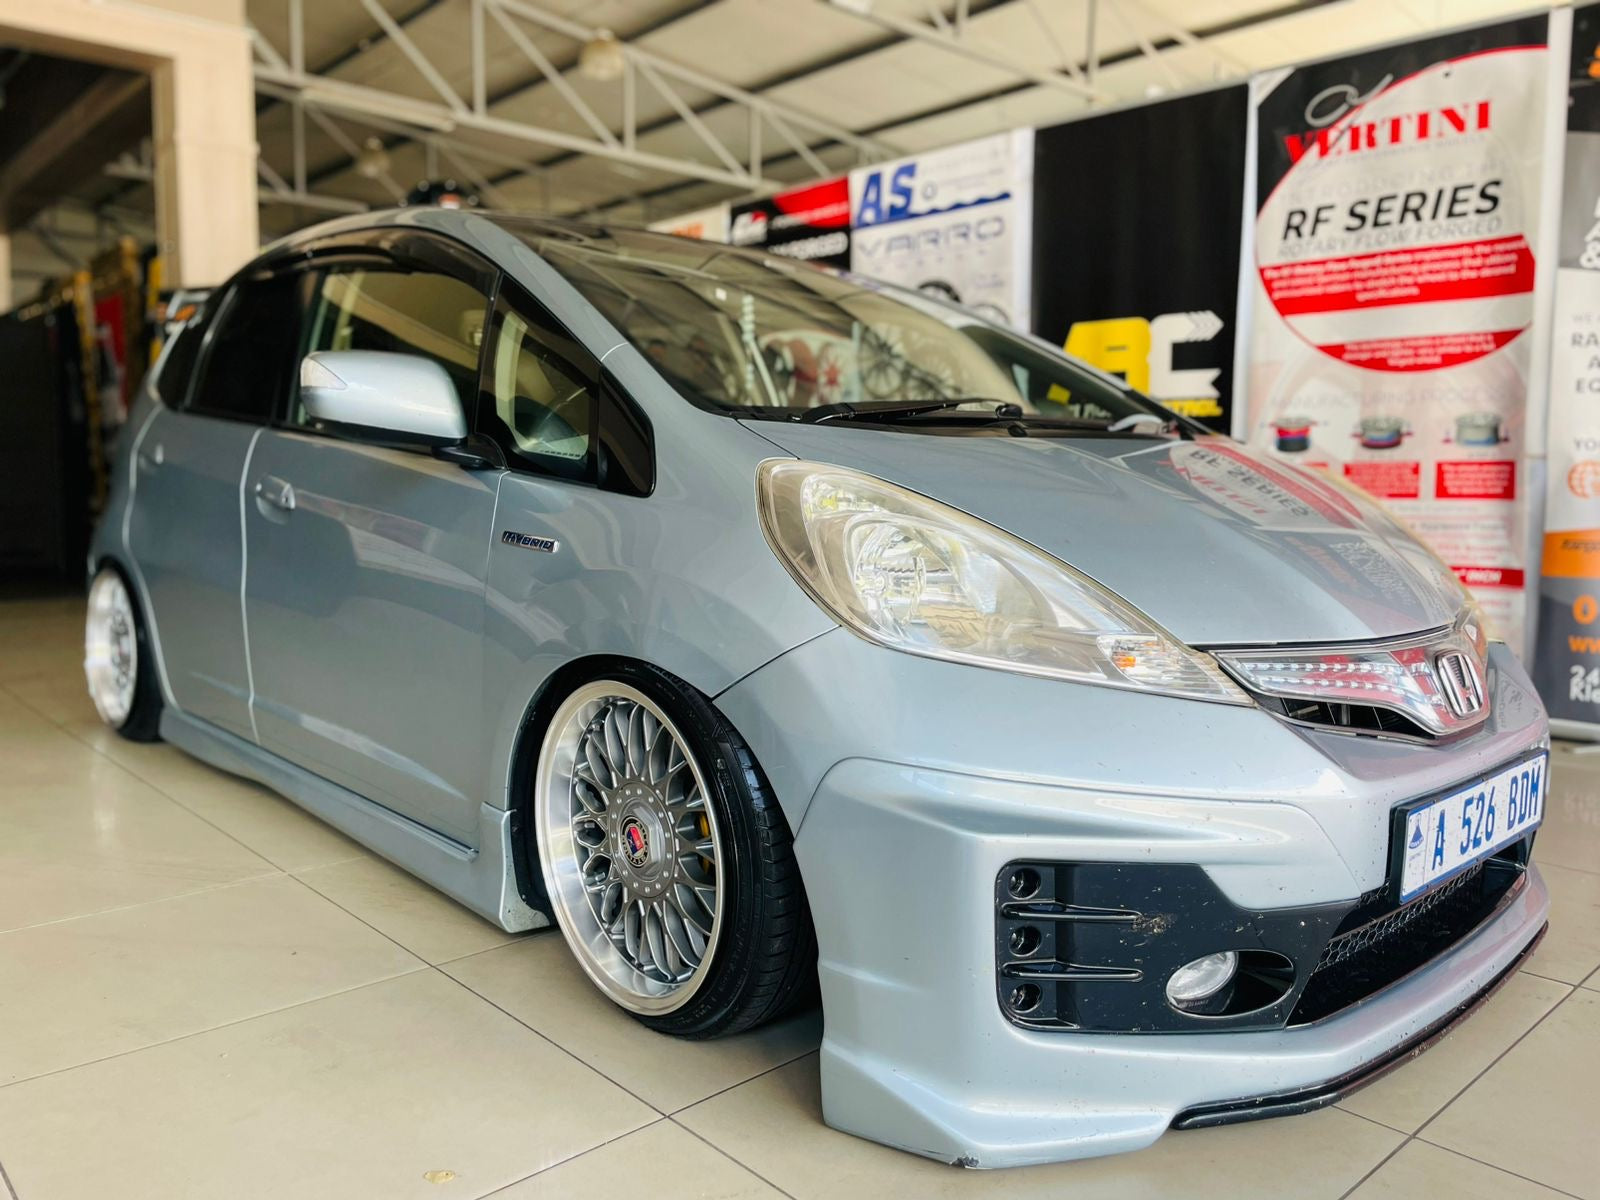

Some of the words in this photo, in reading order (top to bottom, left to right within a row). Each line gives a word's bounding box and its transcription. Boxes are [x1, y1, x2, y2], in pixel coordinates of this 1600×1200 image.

[1284, 101, 1491, 164] VERTINI
[857, 163, 917, 227] AS
[1283, 205, 1335, 241] RF
[1345, 180, 1502, 232] SERIES
[503, 532, 552, 551] HYBRID
[1431, 809, 1446, 871] A
[1459, 786, 1496, 856] 526
[1507, 764, 1542, 831] BDM
